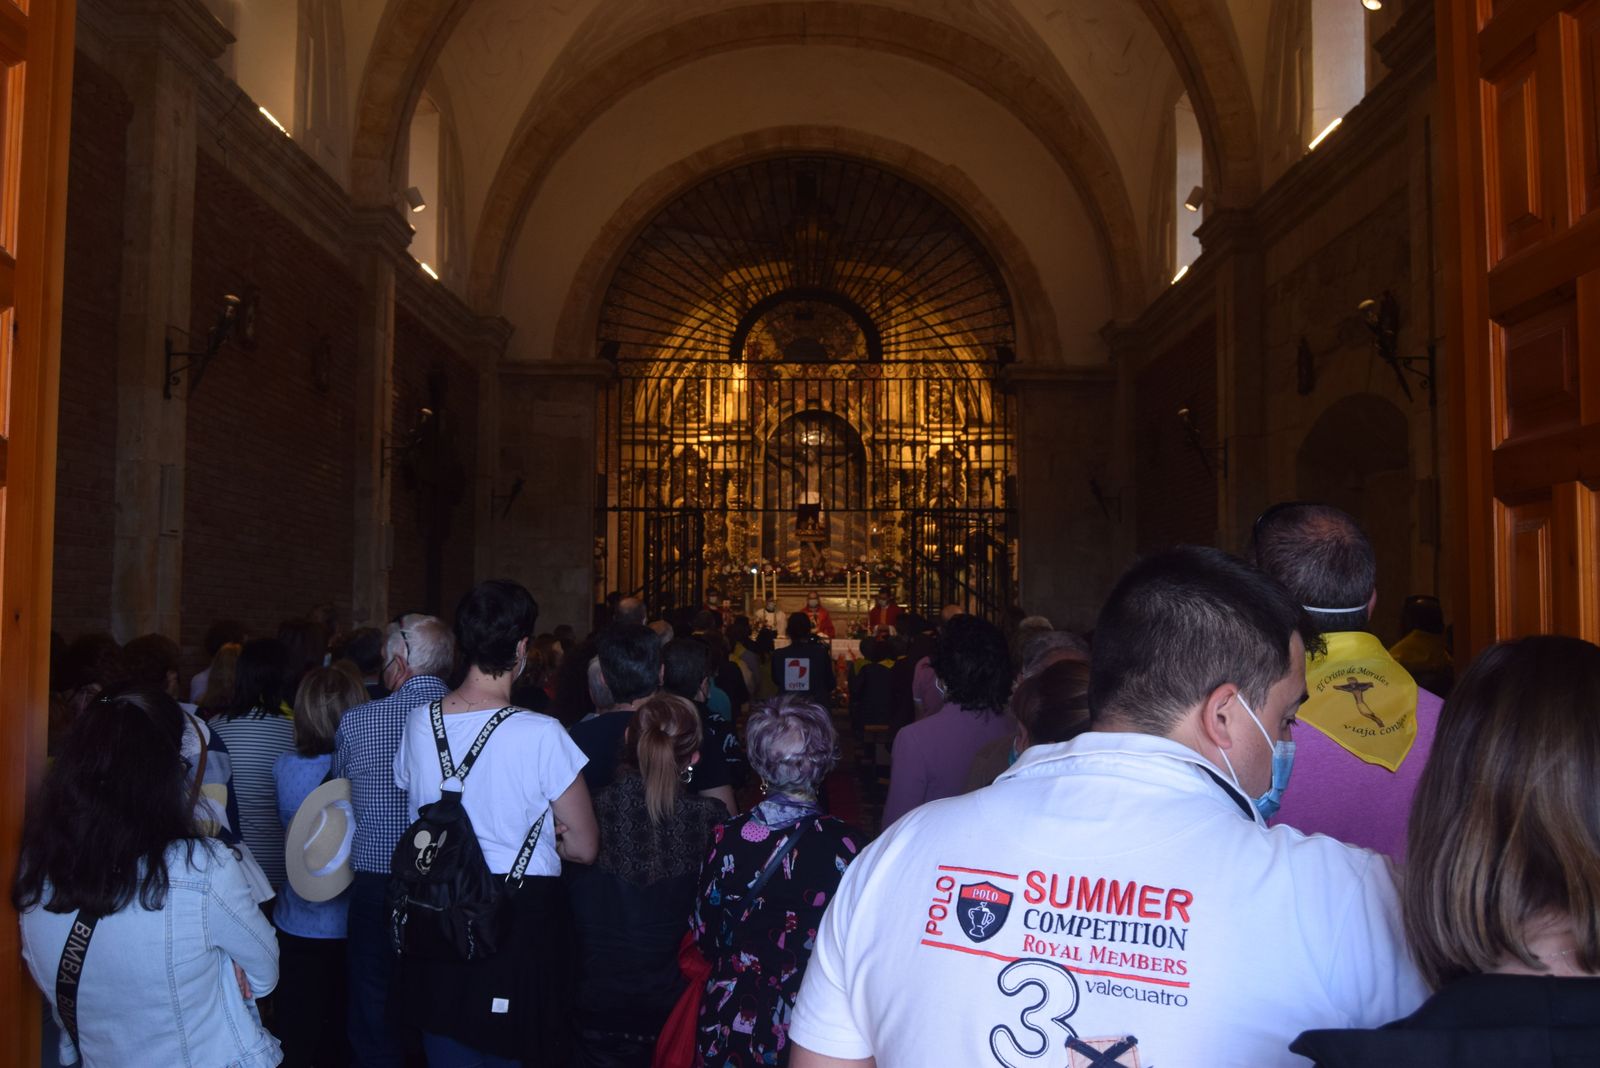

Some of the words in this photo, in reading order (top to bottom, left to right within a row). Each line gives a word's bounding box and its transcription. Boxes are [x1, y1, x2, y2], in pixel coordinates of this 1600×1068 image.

[1323, 668, 1346, 686] Cristo
[1346, 664, 1356, 674] de
[432, 702, 445, 739] MICKEY
[471, 716, 499, 757] MICKEY
[440, 749, 453, 778] OUSE
[511, 846, 531, 880] MOUS
[925, 874, 956, 937] POLO
[971, 888, 999, 901] POLO
[1023, 870, 1194, 924] SUMMER
[1022, 908, 1189, 951] COMPETITION
[58, 920, 92, 985] BIMBA
[1022, 934, 1082, 962] ROYAL
[1089, 945, 1188, 976] MEMBERS
[988, 957, 1080, 1068] 3
[1085, 979, 1189, 1008] valecuatro
